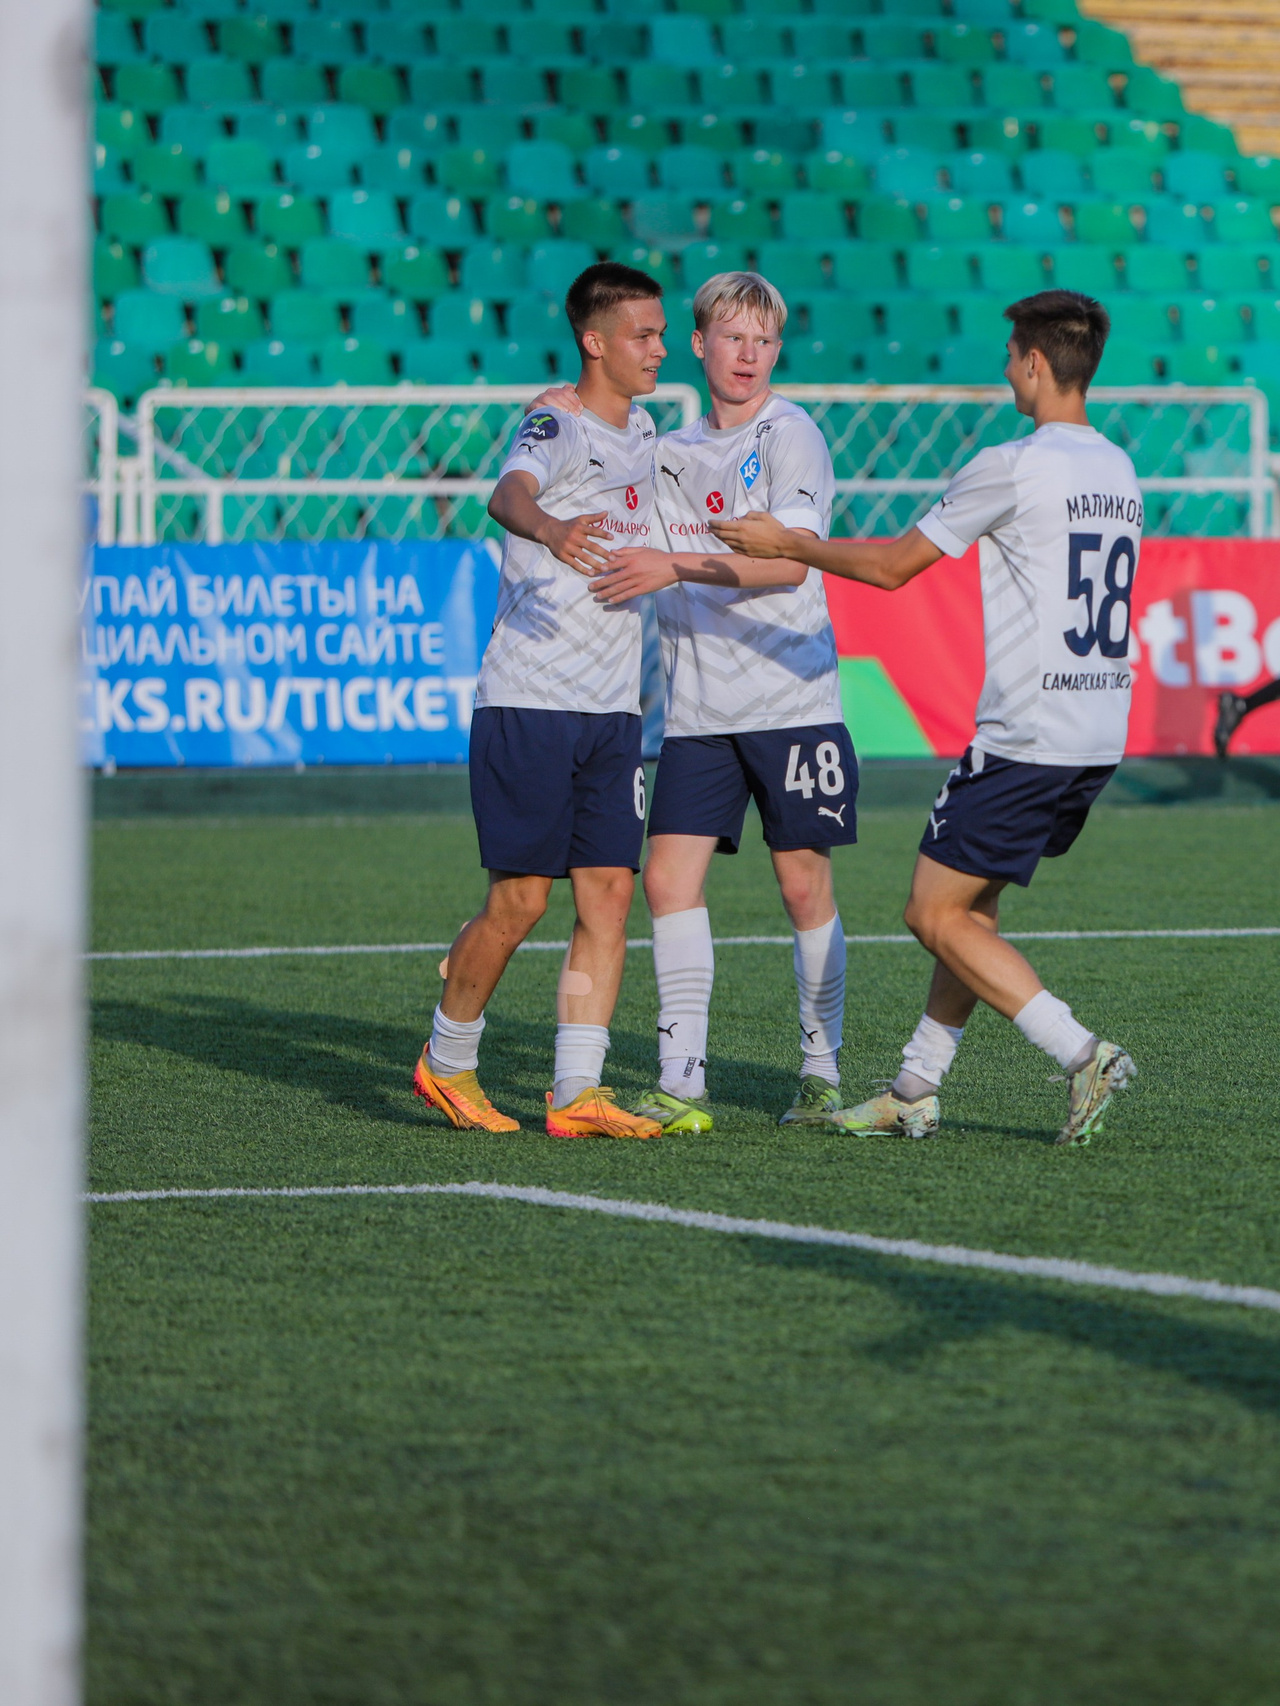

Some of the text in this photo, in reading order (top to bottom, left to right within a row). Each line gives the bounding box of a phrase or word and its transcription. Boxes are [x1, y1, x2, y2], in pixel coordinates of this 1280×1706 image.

[1066, 493, 1143, 527] МАЛИКОВ
[187, 574, 355, 618] БИЛЕТЫ
[367, 574, 424, 616] НА
[1063, 532, 1136, 658] 58
[315, 613, 446, 666] САЙТЕ
[1042, 672, 1107, 691] САМАРСКАЯ
[785, 741, 845, 799] 48
